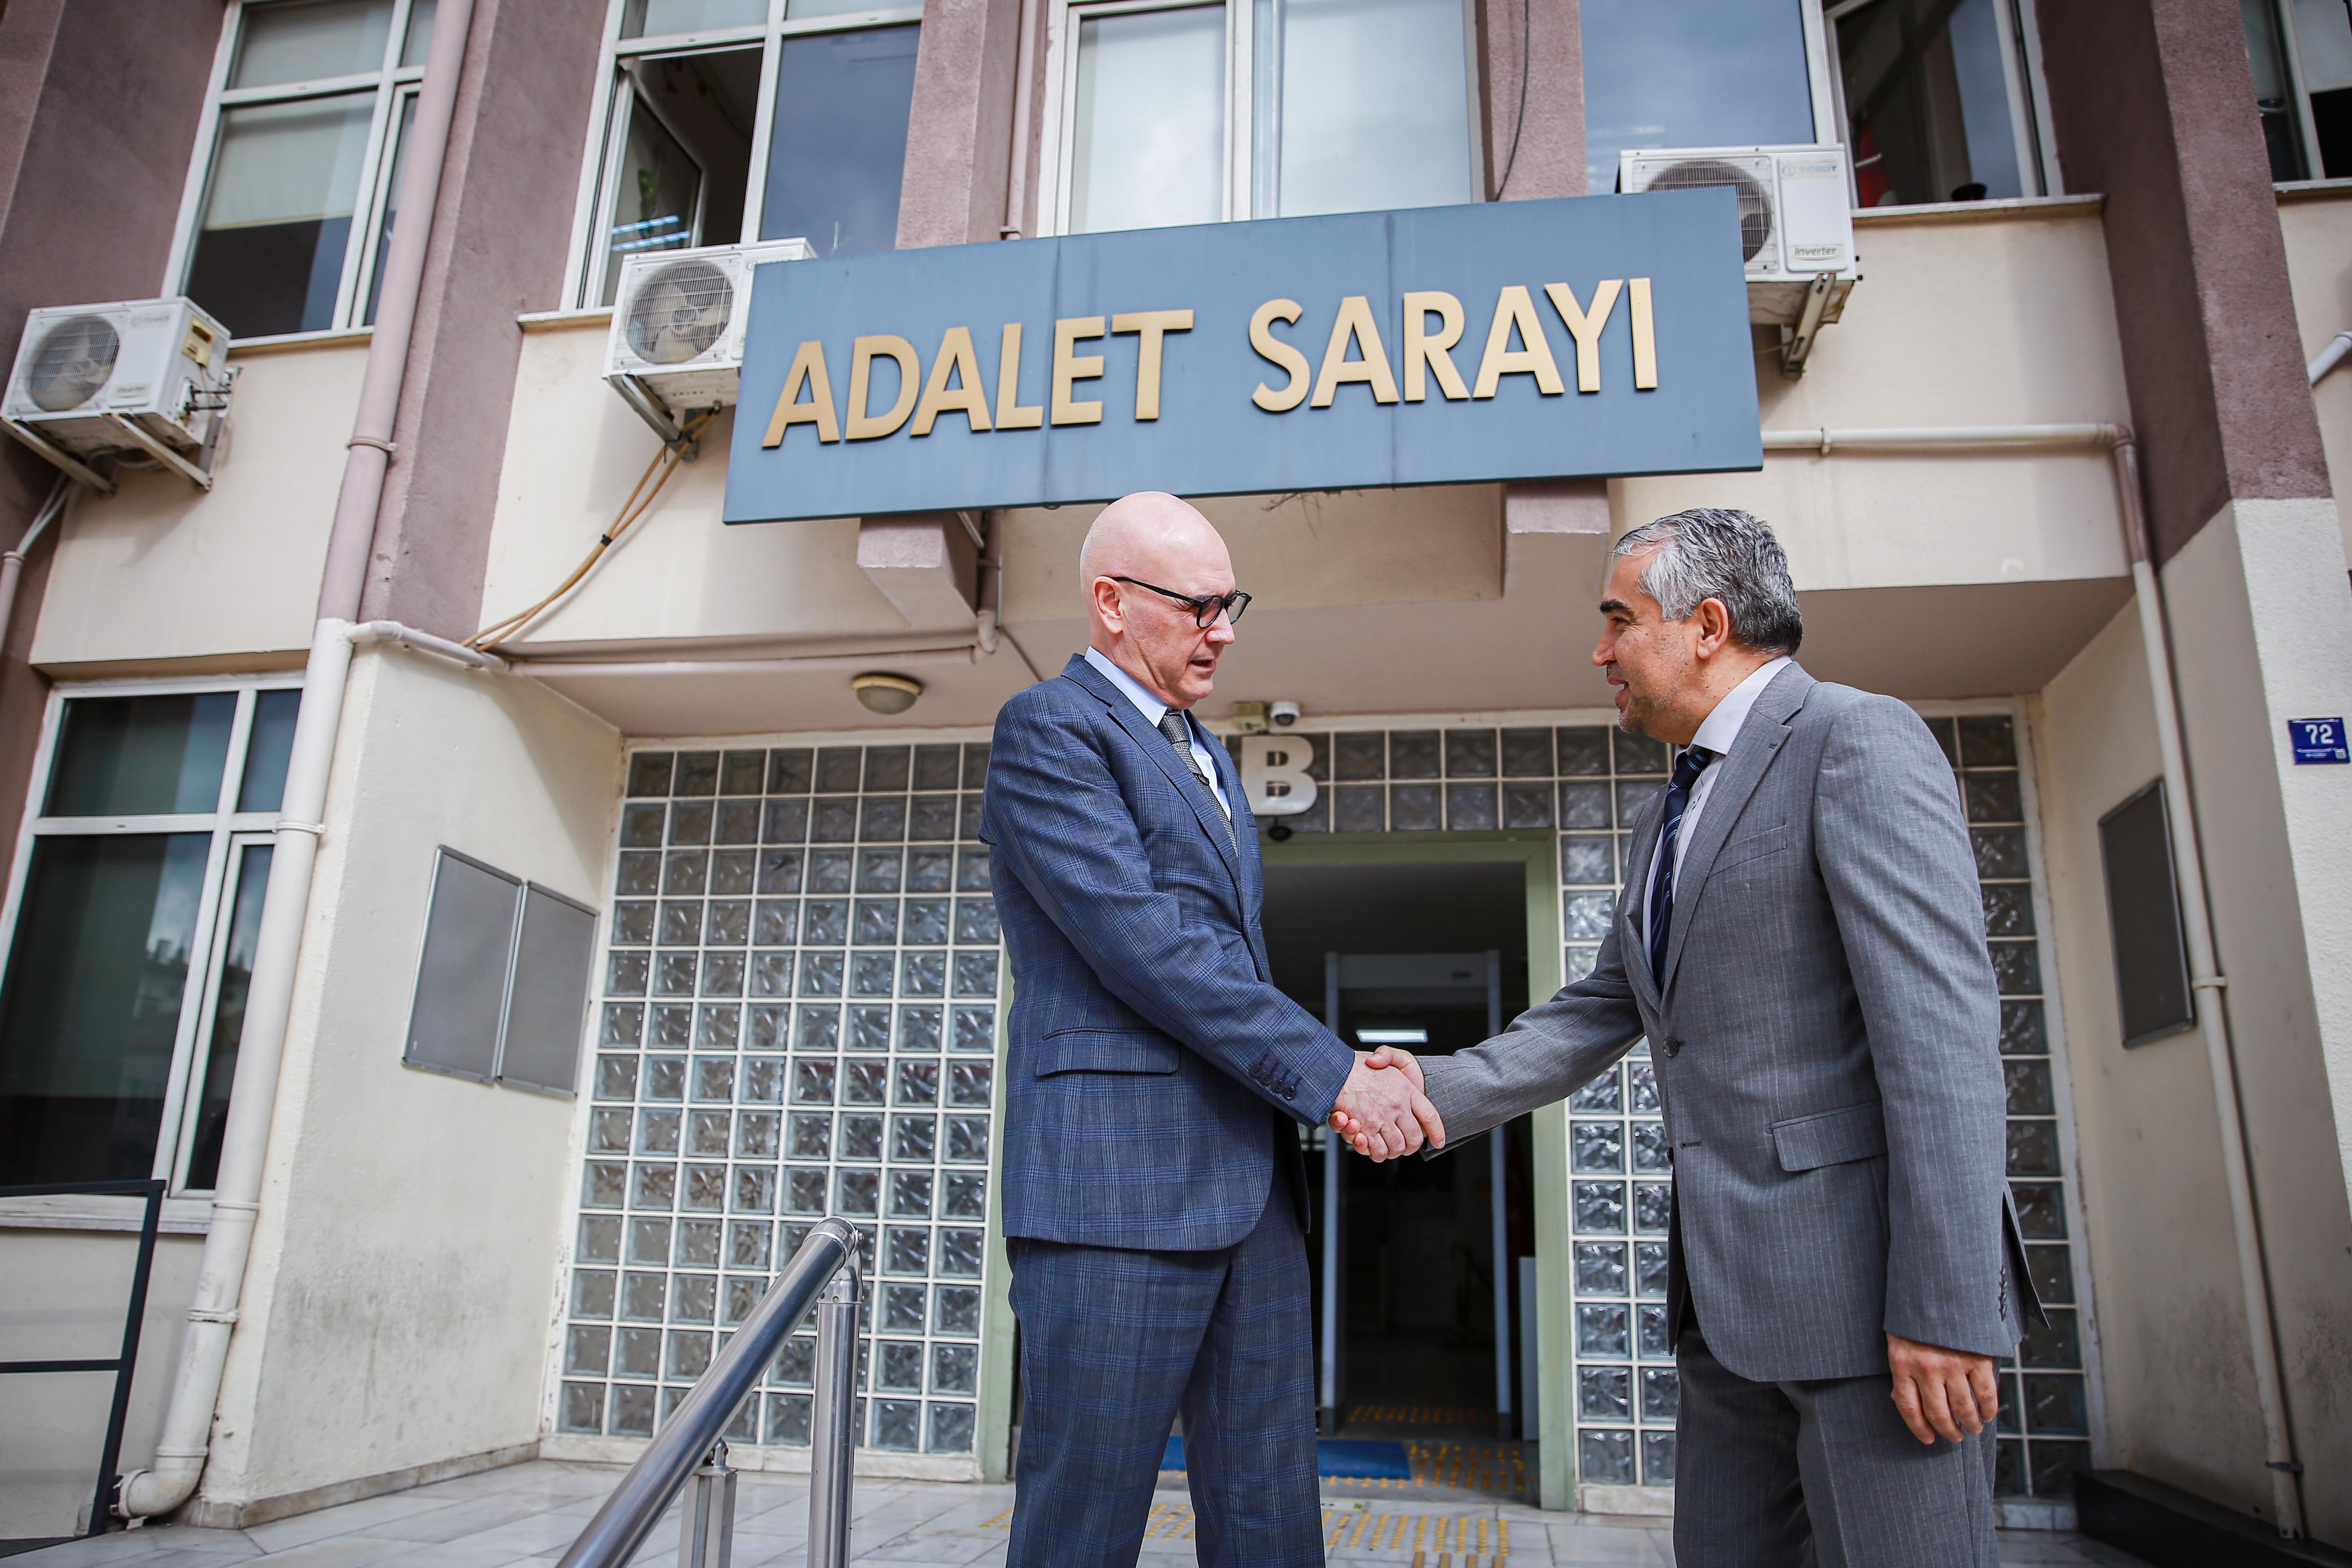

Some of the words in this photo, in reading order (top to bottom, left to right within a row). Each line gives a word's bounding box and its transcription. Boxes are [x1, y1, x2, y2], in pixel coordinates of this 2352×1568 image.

[762, 310, 1194, 448] ADALET
[1249, 277, 1657, 412] SARAYI
[2305, 724, 2334, 745] 72
[1241, 736, 1317, 815] B
